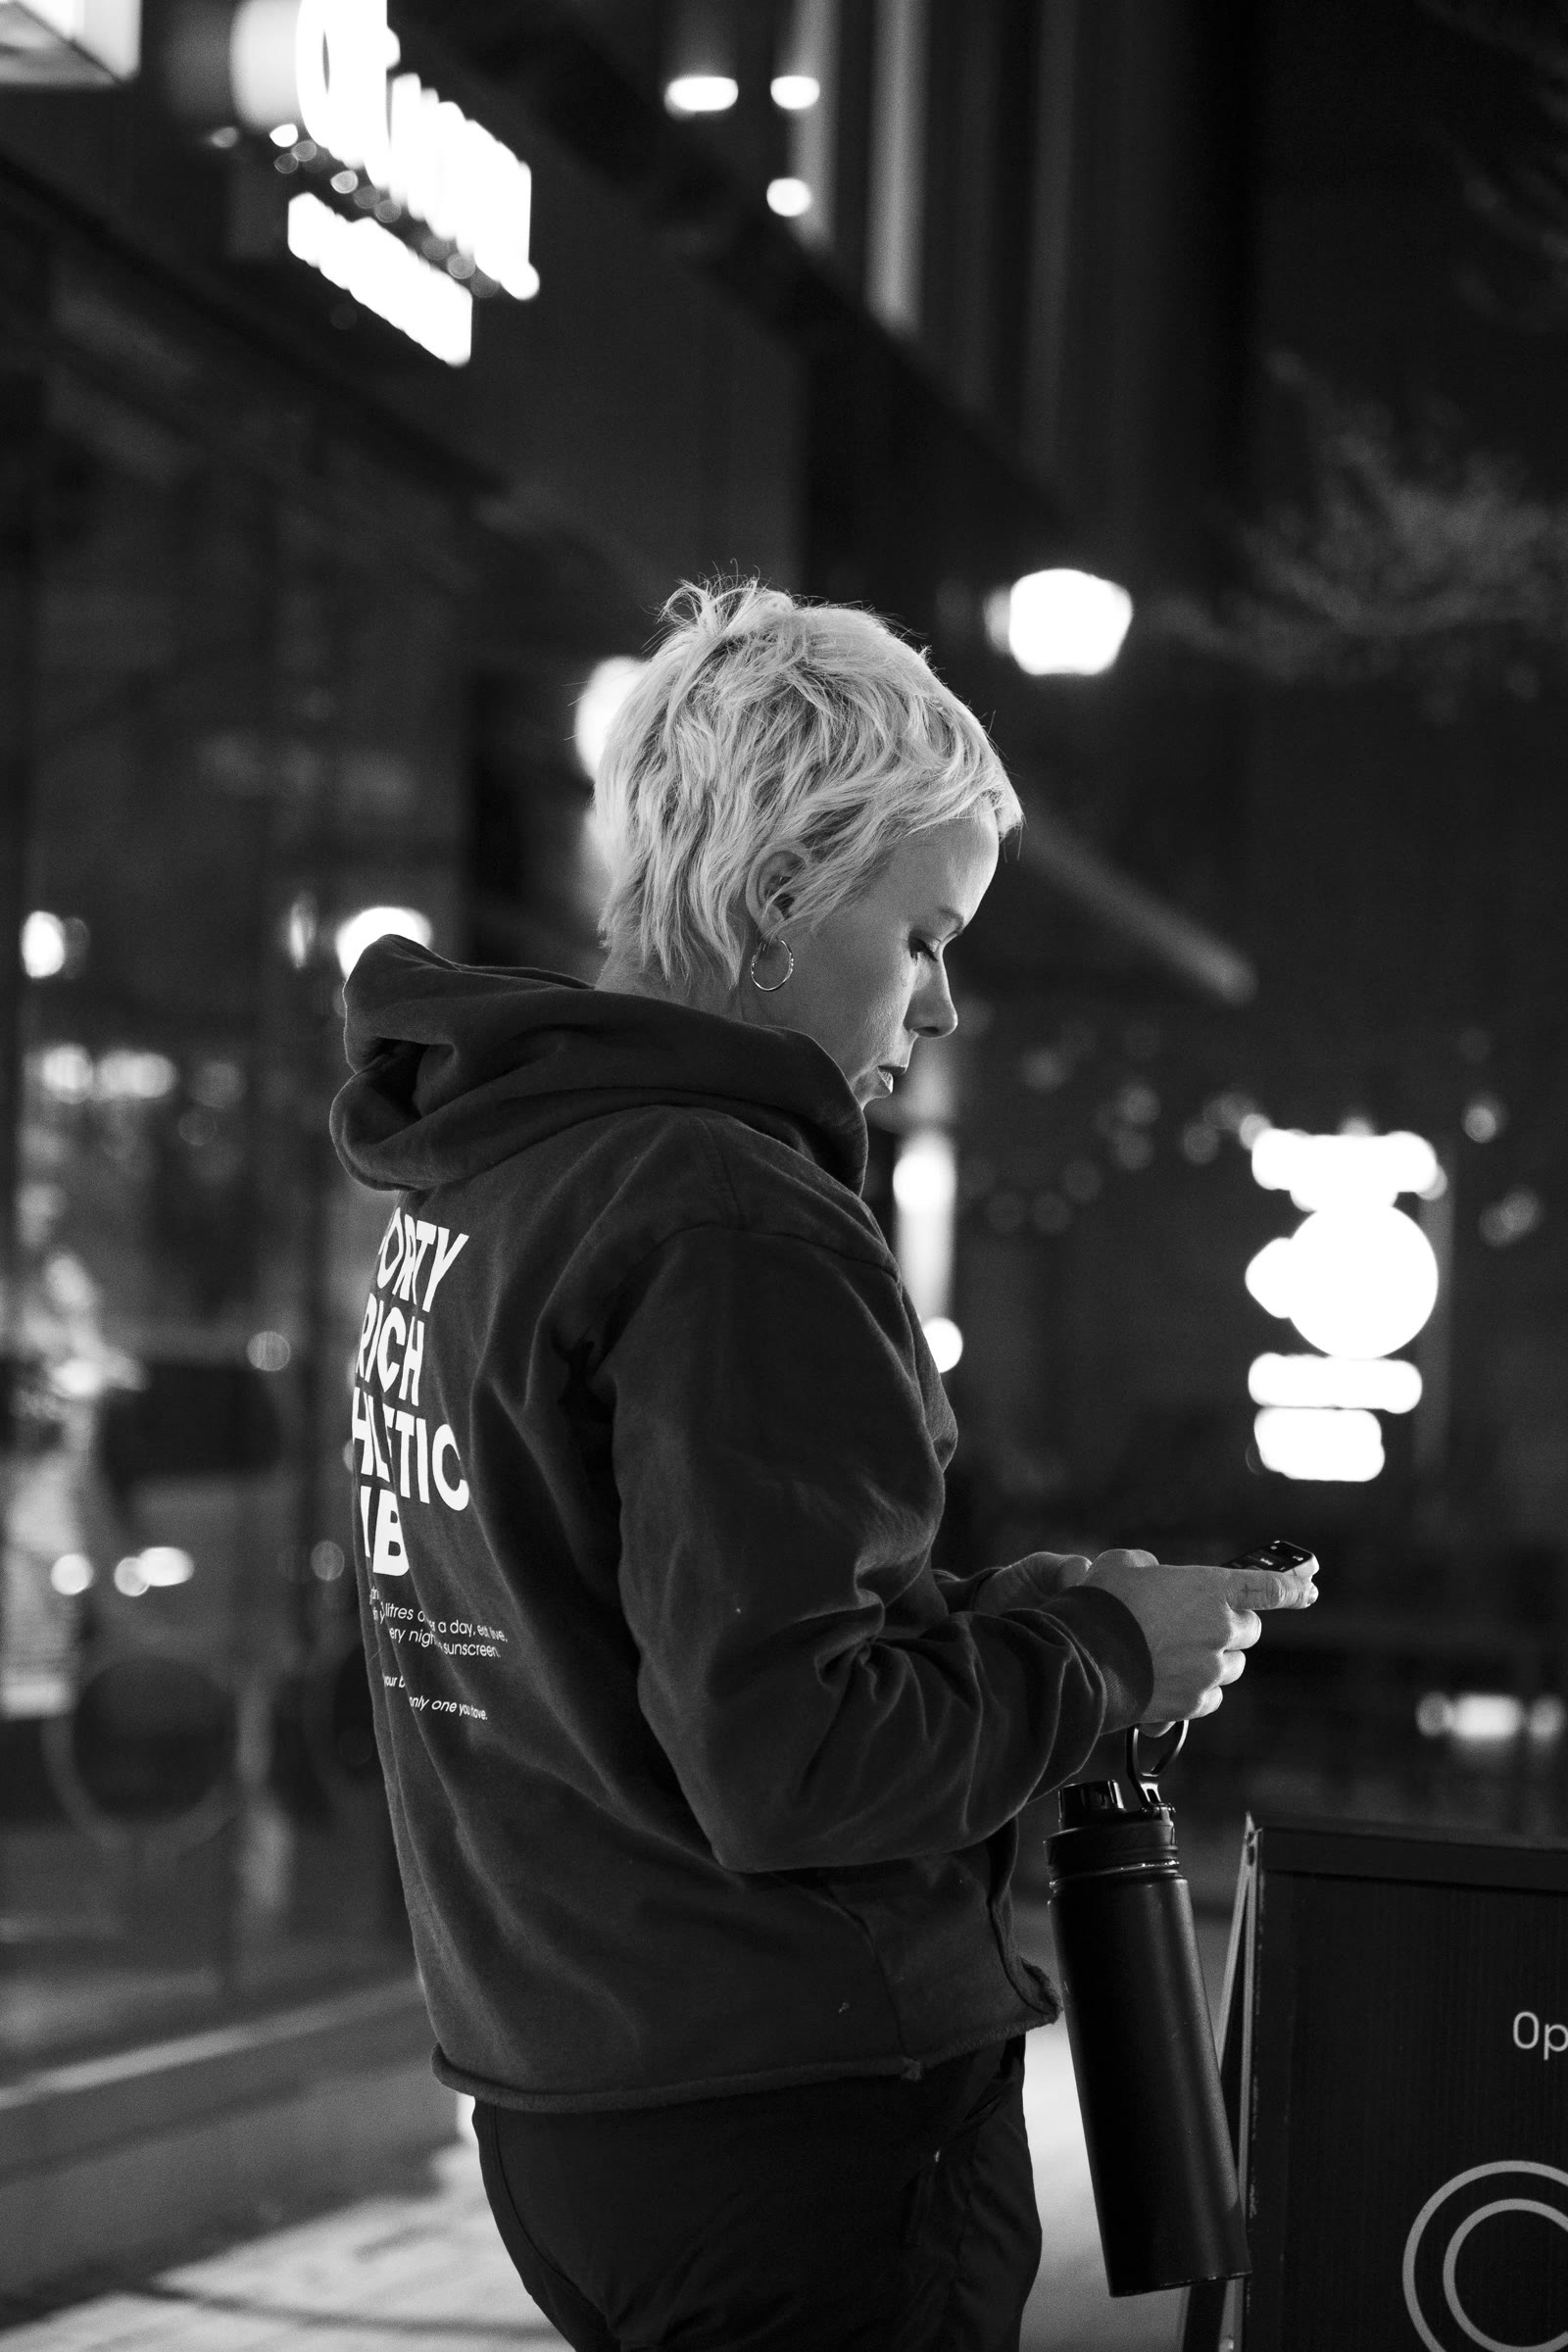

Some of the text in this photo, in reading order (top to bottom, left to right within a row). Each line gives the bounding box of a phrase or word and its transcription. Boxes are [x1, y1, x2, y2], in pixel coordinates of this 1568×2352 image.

[377, 1207, 469, 1312] ORTY
[352, 1386, 470, 1511] HLTIC
[385, 1602, 415, 1621] litres
[438, 1621, 447, 1634] a
[450, 1619, 476, 1639] day,
[389, 1627, 406, 1643] ery
[409, 1629, 435, 1647] nigh
[431, 1700, 457, 1713] one
